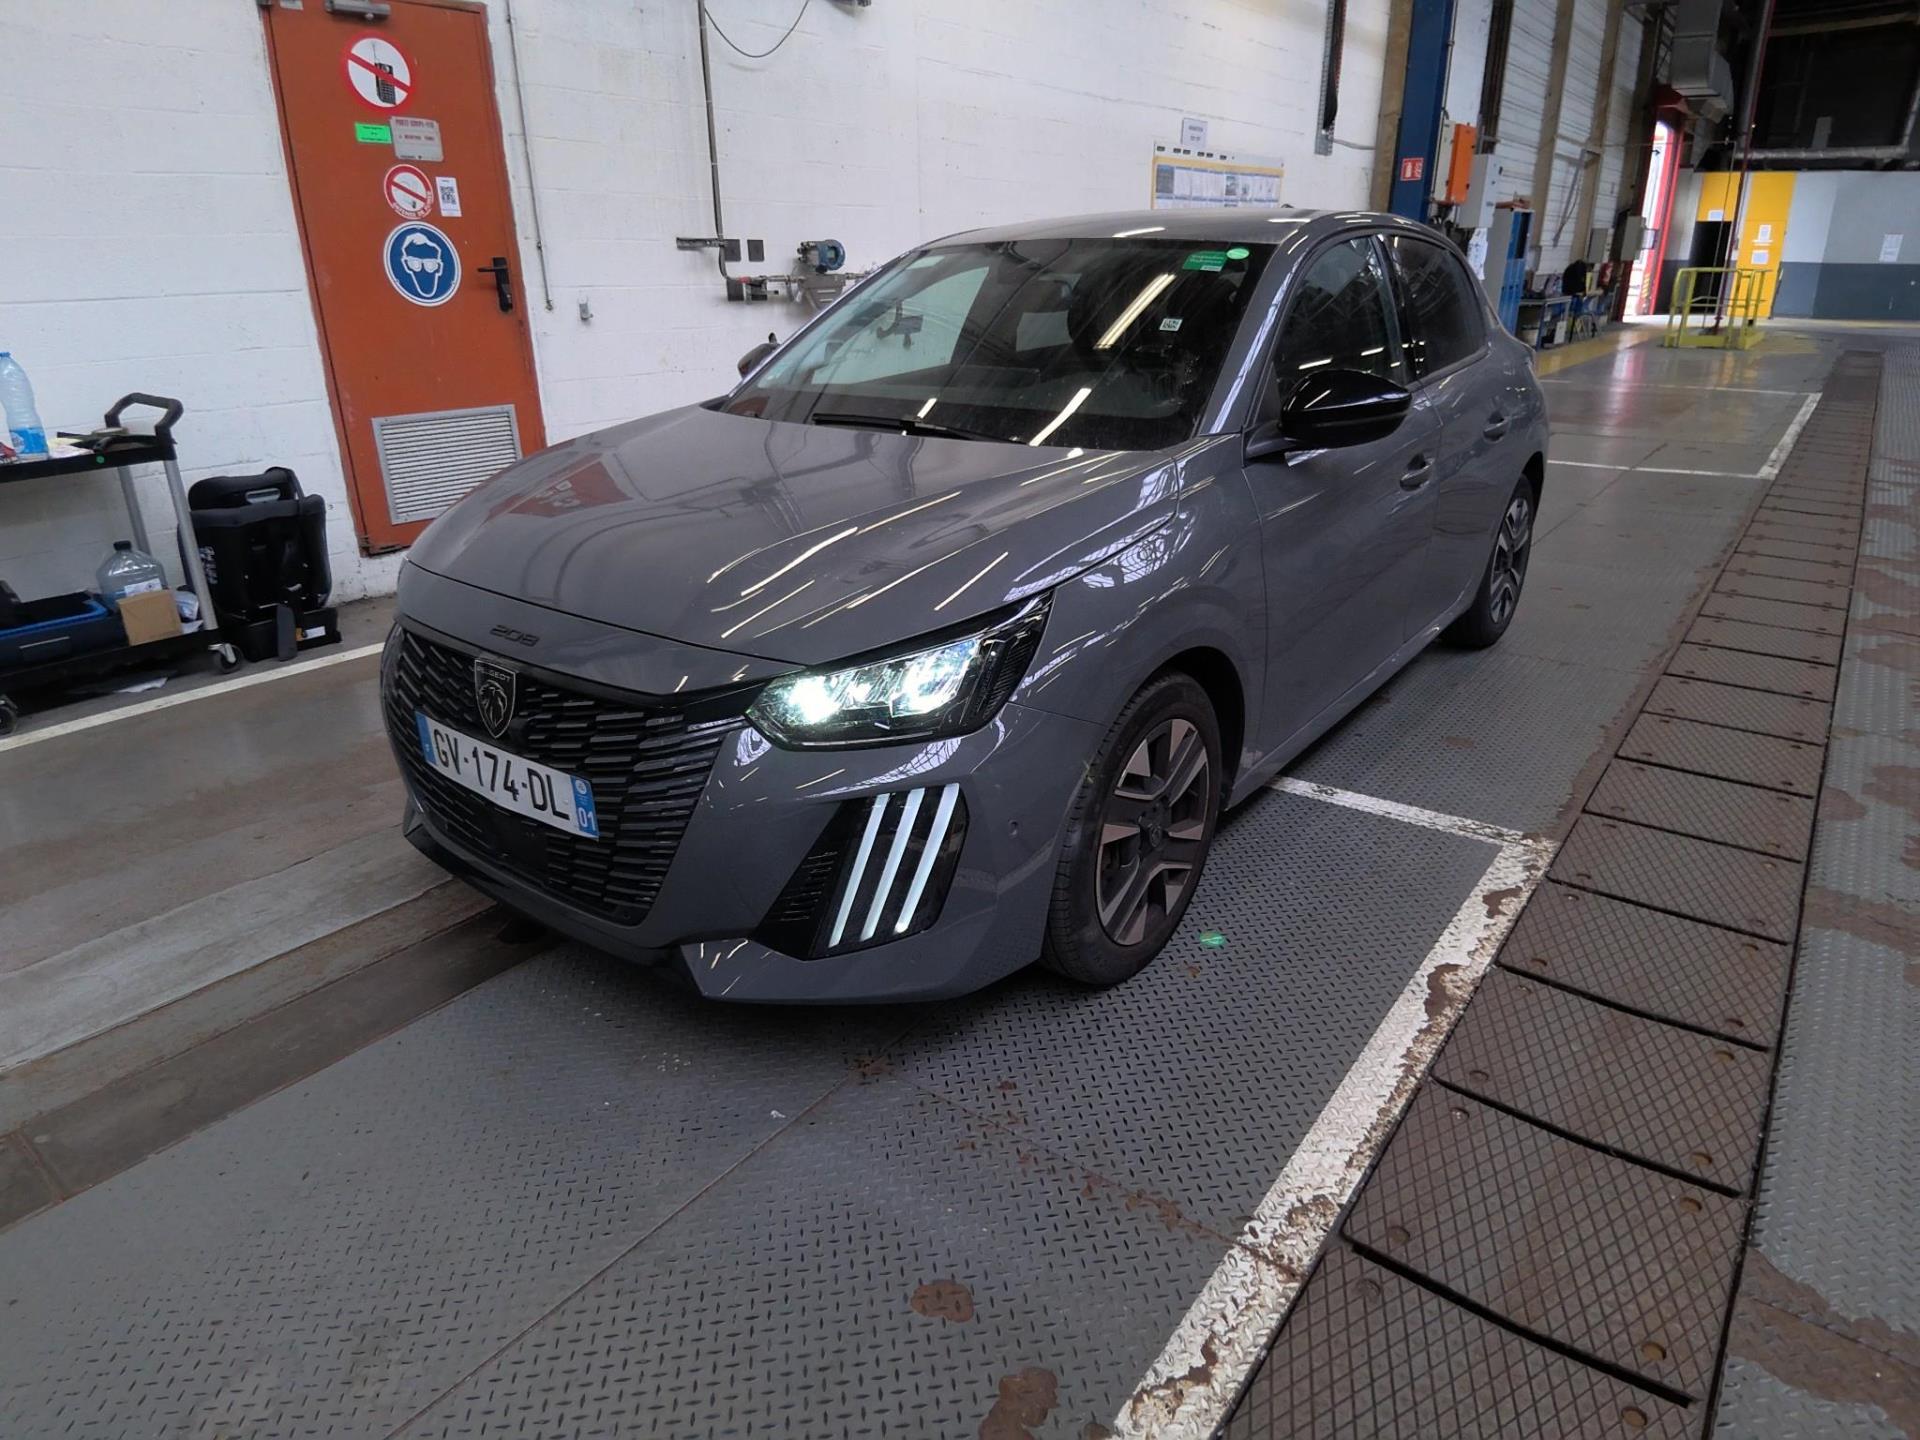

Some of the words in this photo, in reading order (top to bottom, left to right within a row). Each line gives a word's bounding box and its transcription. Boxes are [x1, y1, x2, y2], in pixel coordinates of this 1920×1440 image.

[489, 624, 541, 647] 208
[433, 728, 571, 821] GV-174-DL
[577, 806, 596, 832] 01
